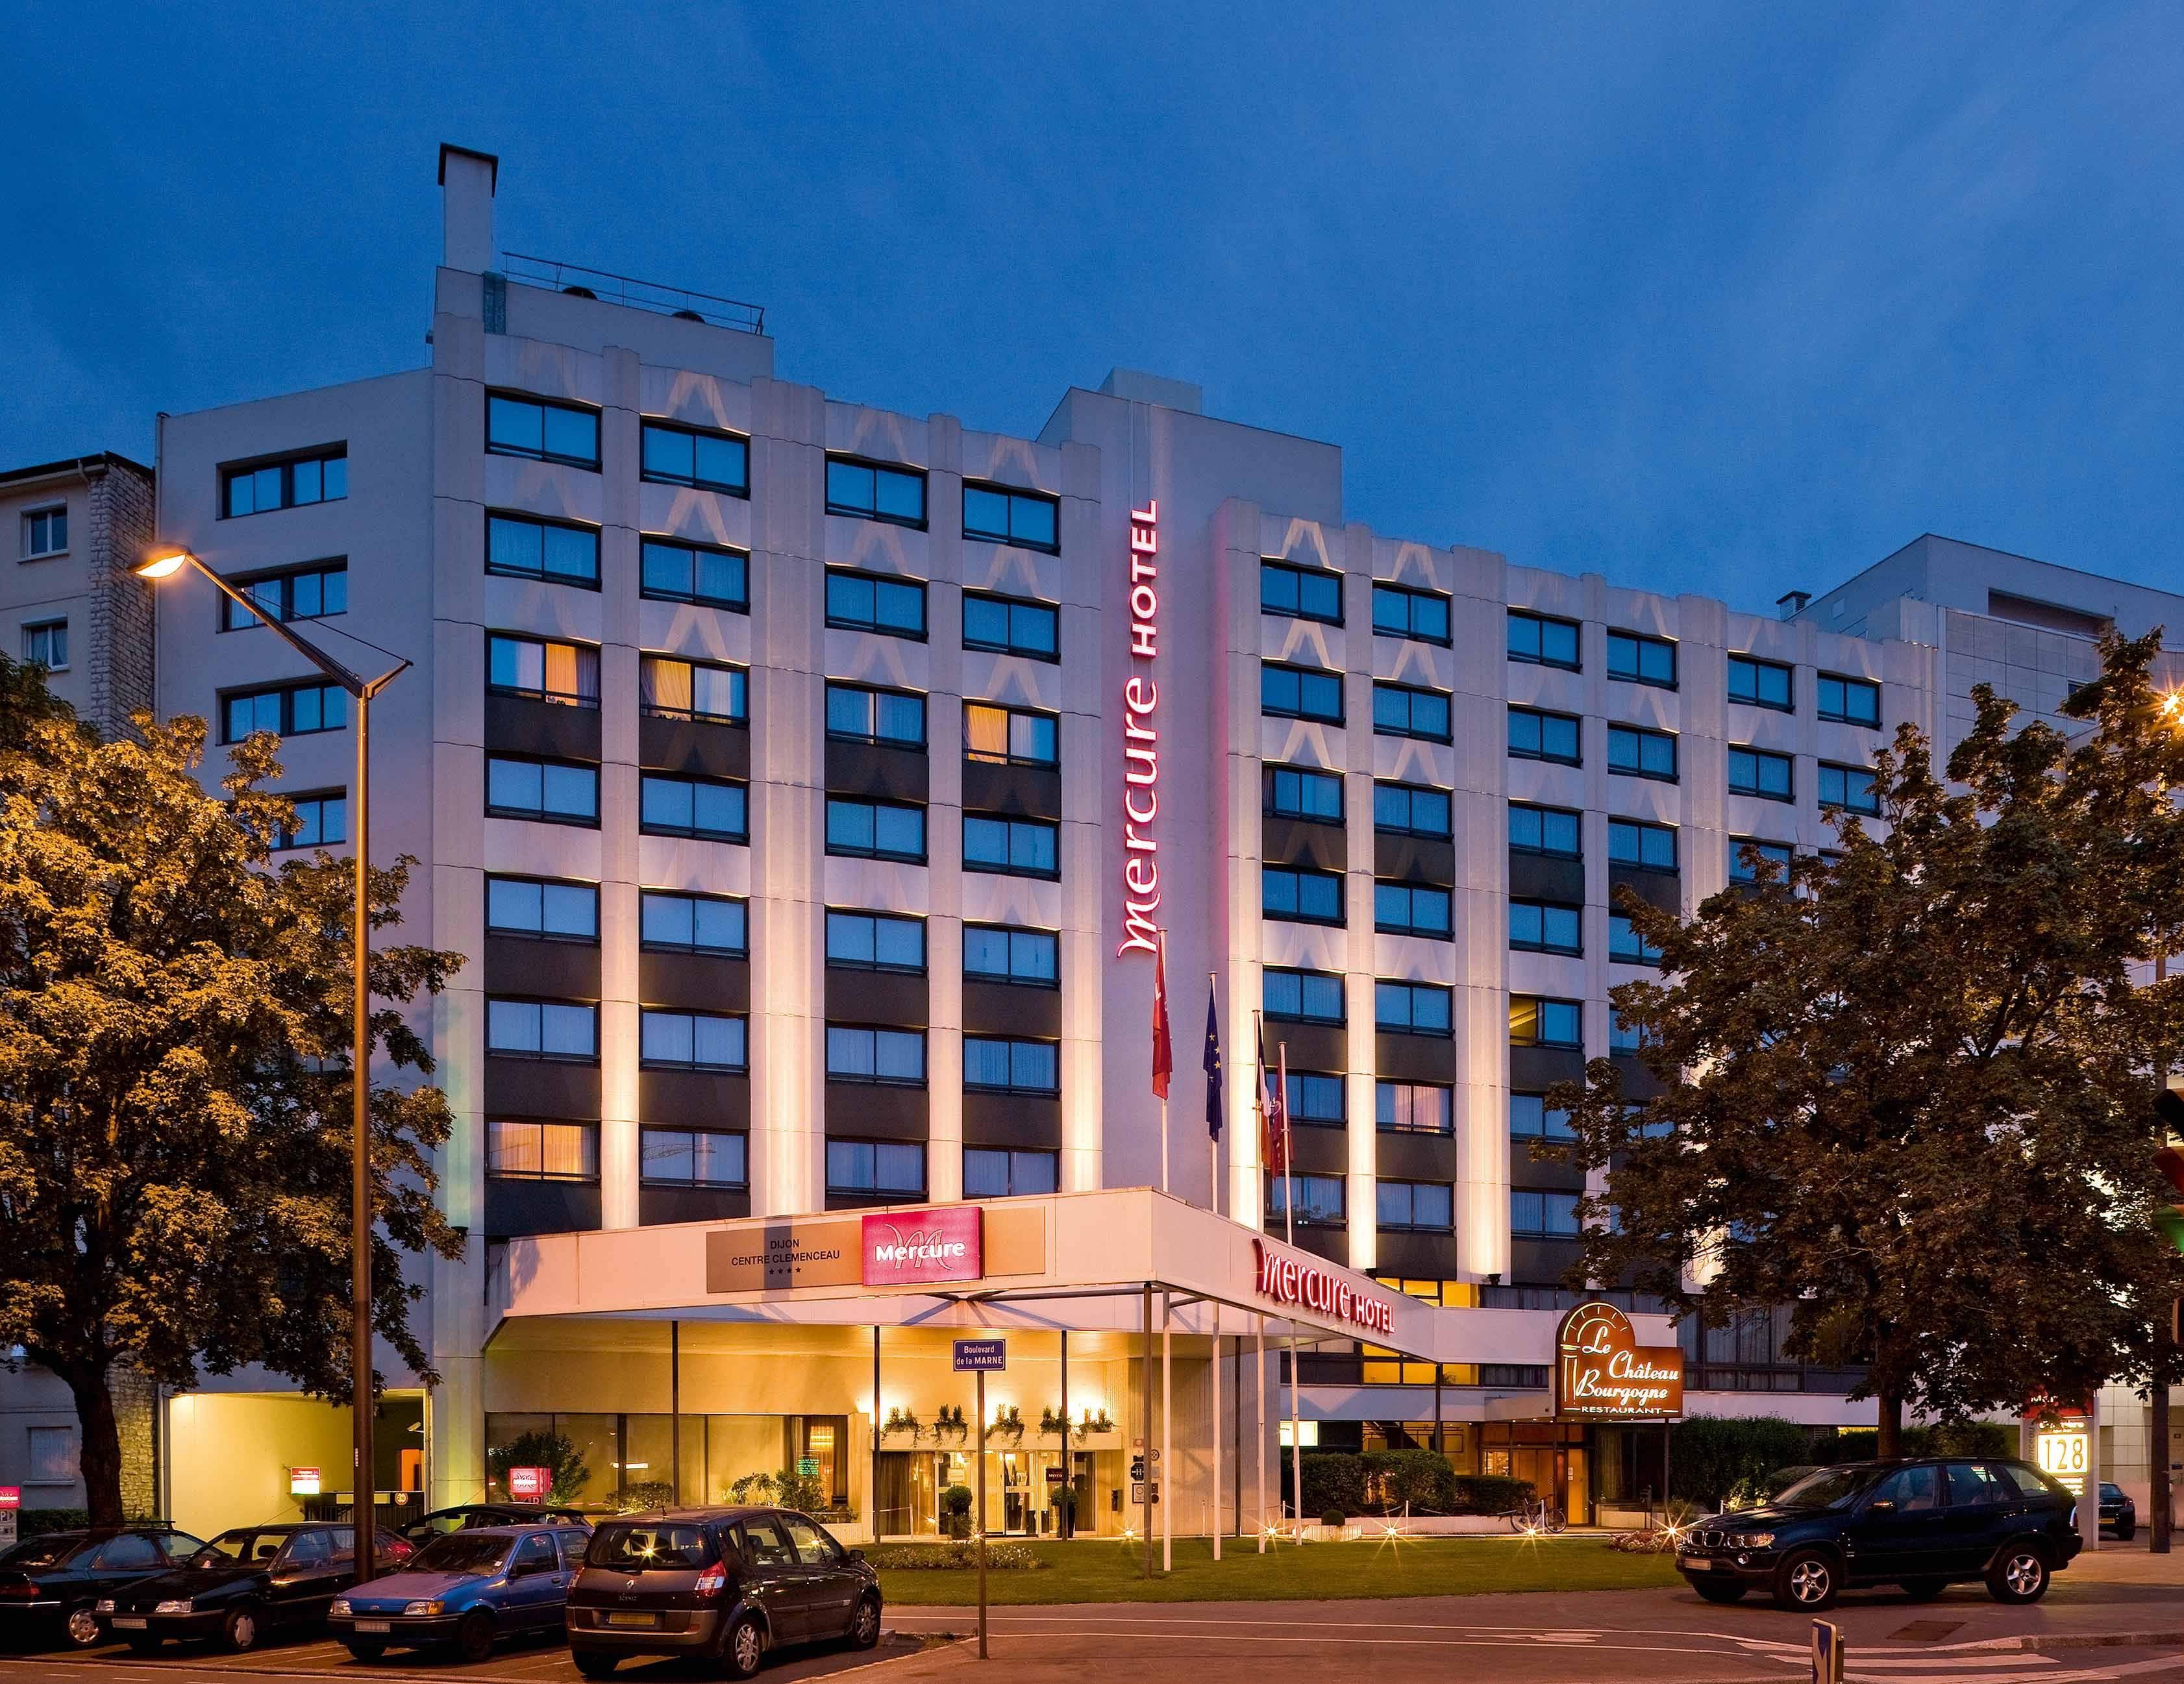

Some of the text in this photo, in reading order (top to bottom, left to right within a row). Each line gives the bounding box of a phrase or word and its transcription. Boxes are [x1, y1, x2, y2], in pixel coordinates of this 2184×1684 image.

[1130, 499, 1158, 658] HOTEL
[770, 1239, 800, 1249] DIJON
[876, 1241, 966, 1261] Mercure
[732, 1250, 840, 1266] CENTRE CLEMENCEAU
[1355, 1293, 1396, 1333] HOTEL
[963, 1344, 995, 1354] Boulevard
[1582, 1326, 1611, 1354] Le
[974, 1356, 1003, 1365] MARNE
[1608, 1350, 1679, 1381] Château
[1576, 1368, 1668, 1407] Bourgogne
[1582, 1406, 1663, 1415] RESTAURANT
